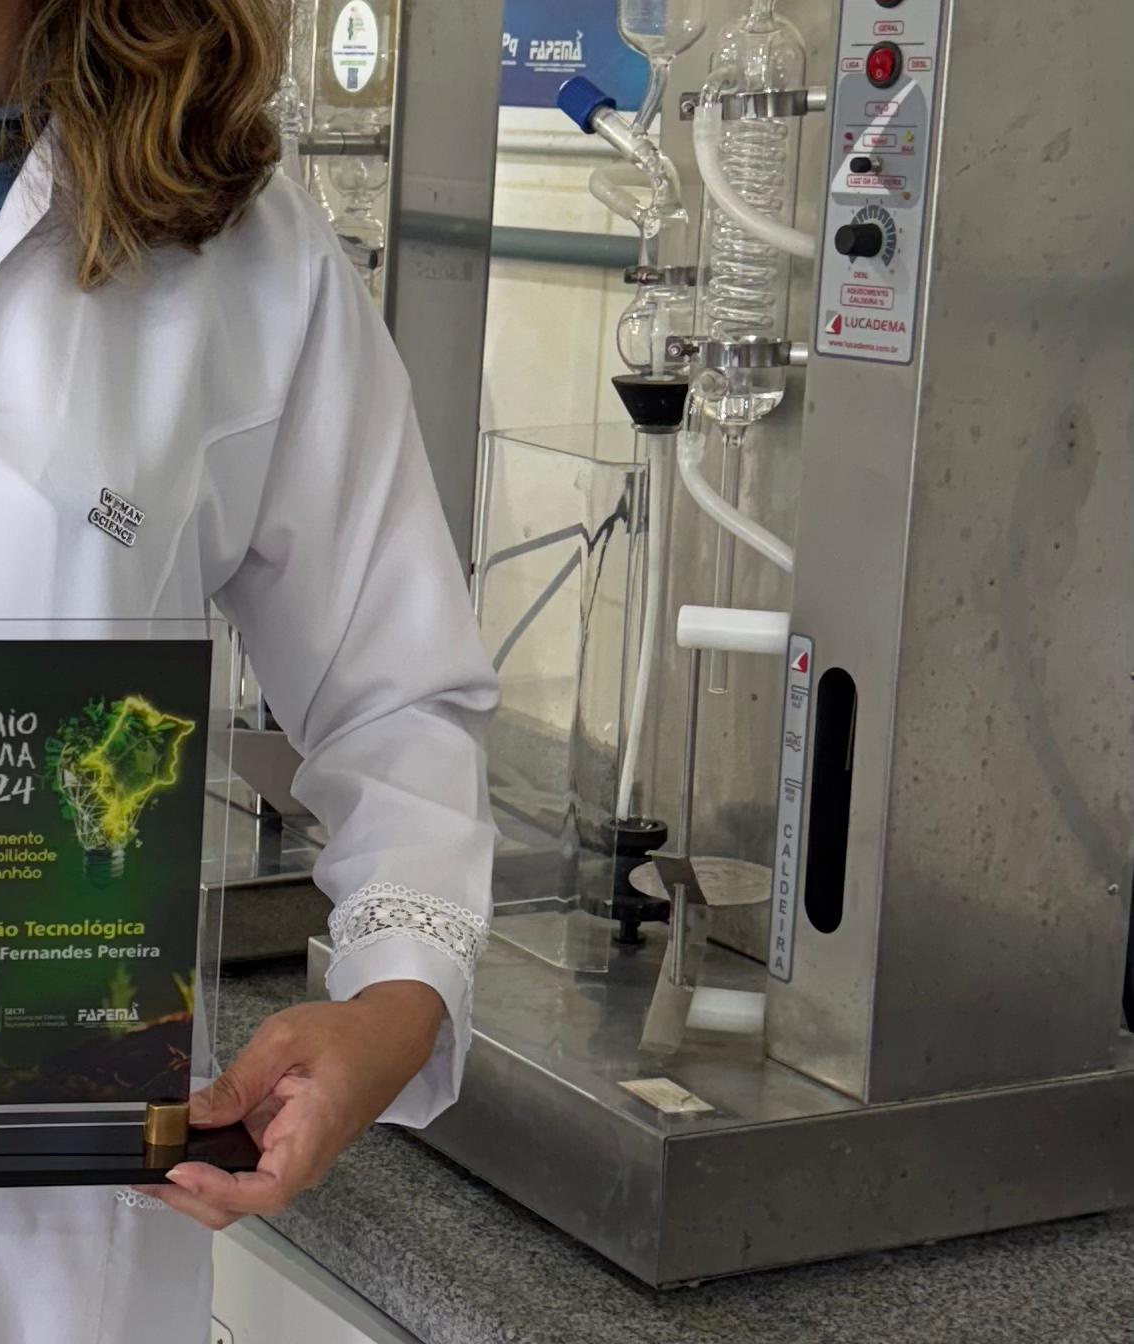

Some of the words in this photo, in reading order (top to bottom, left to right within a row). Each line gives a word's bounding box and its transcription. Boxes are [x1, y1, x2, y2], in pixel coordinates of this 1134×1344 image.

[845, 316, 906, 333] LUCADEMA
[828, 340, 898, 353] www.lucadema.com.br
[92, 512, 134, 543] SCIENCE
[774, 823, 794, 972] CALDEIRA
[25, 919, 145, 940] Tecnológica
[0, 945, 93, 961] Fernandes
[97, 944, 160, 959] Pereira
